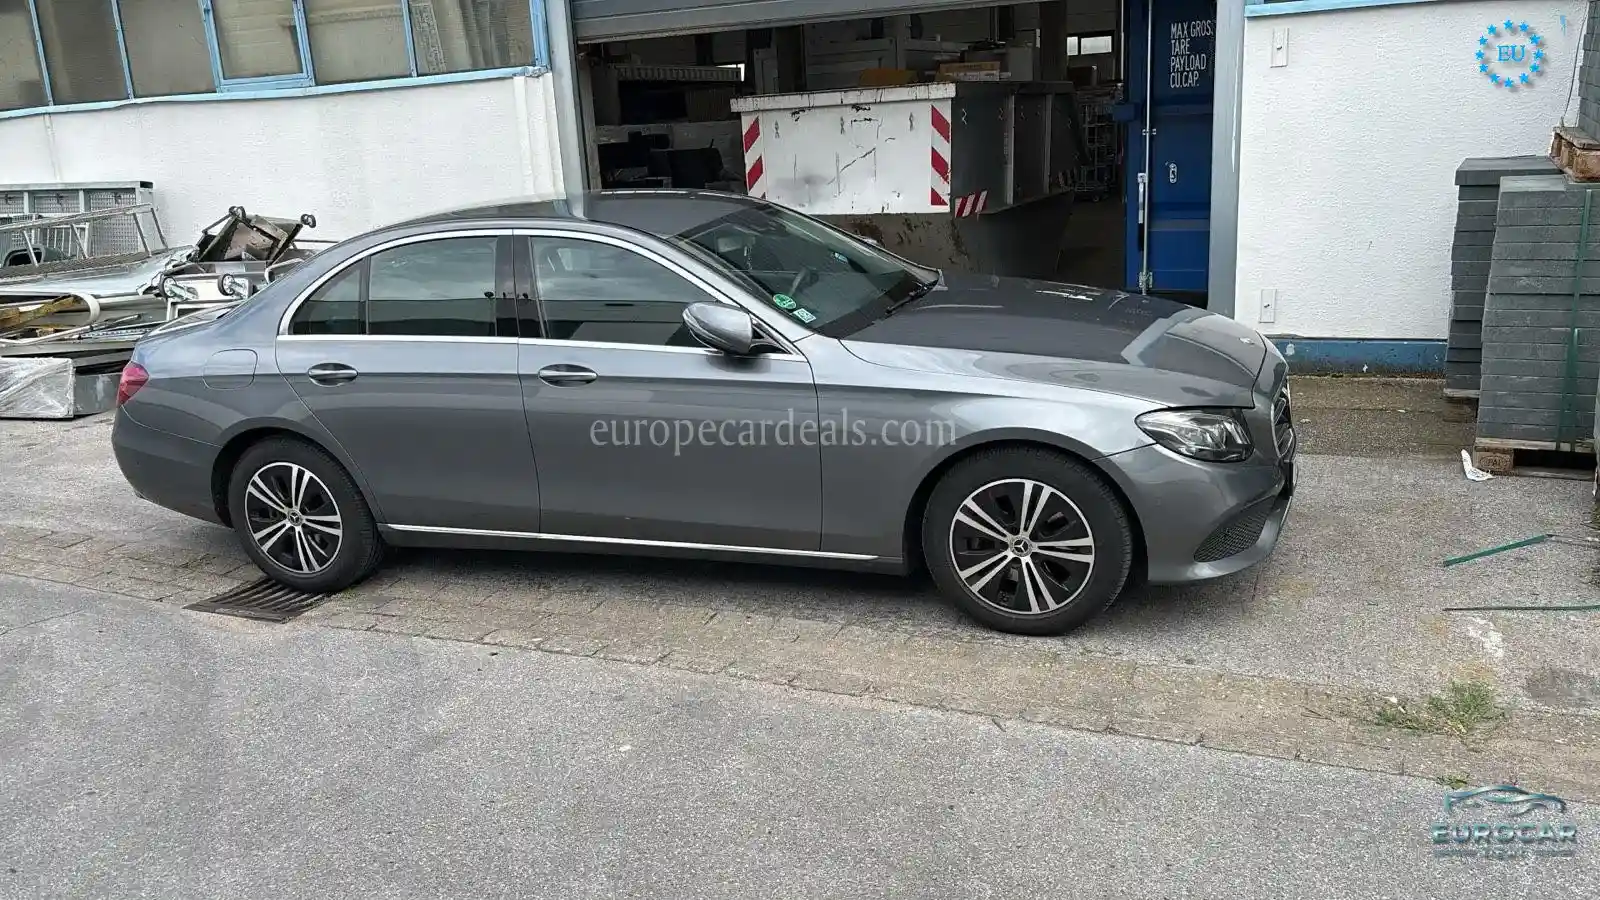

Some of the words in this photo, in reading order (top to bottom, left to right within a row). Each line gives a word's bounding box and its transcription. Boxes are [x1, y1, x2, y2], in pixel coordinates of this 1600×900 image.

[1170, 22, 1189, 39] MAX
[1190, 20, 1214, 38] GROS
[1170, 38, 1191, 56] TARE
[1170, 54, 1207, 72] PAYLOAD
[1170, 71, 1199, 88] CU.CAP.
